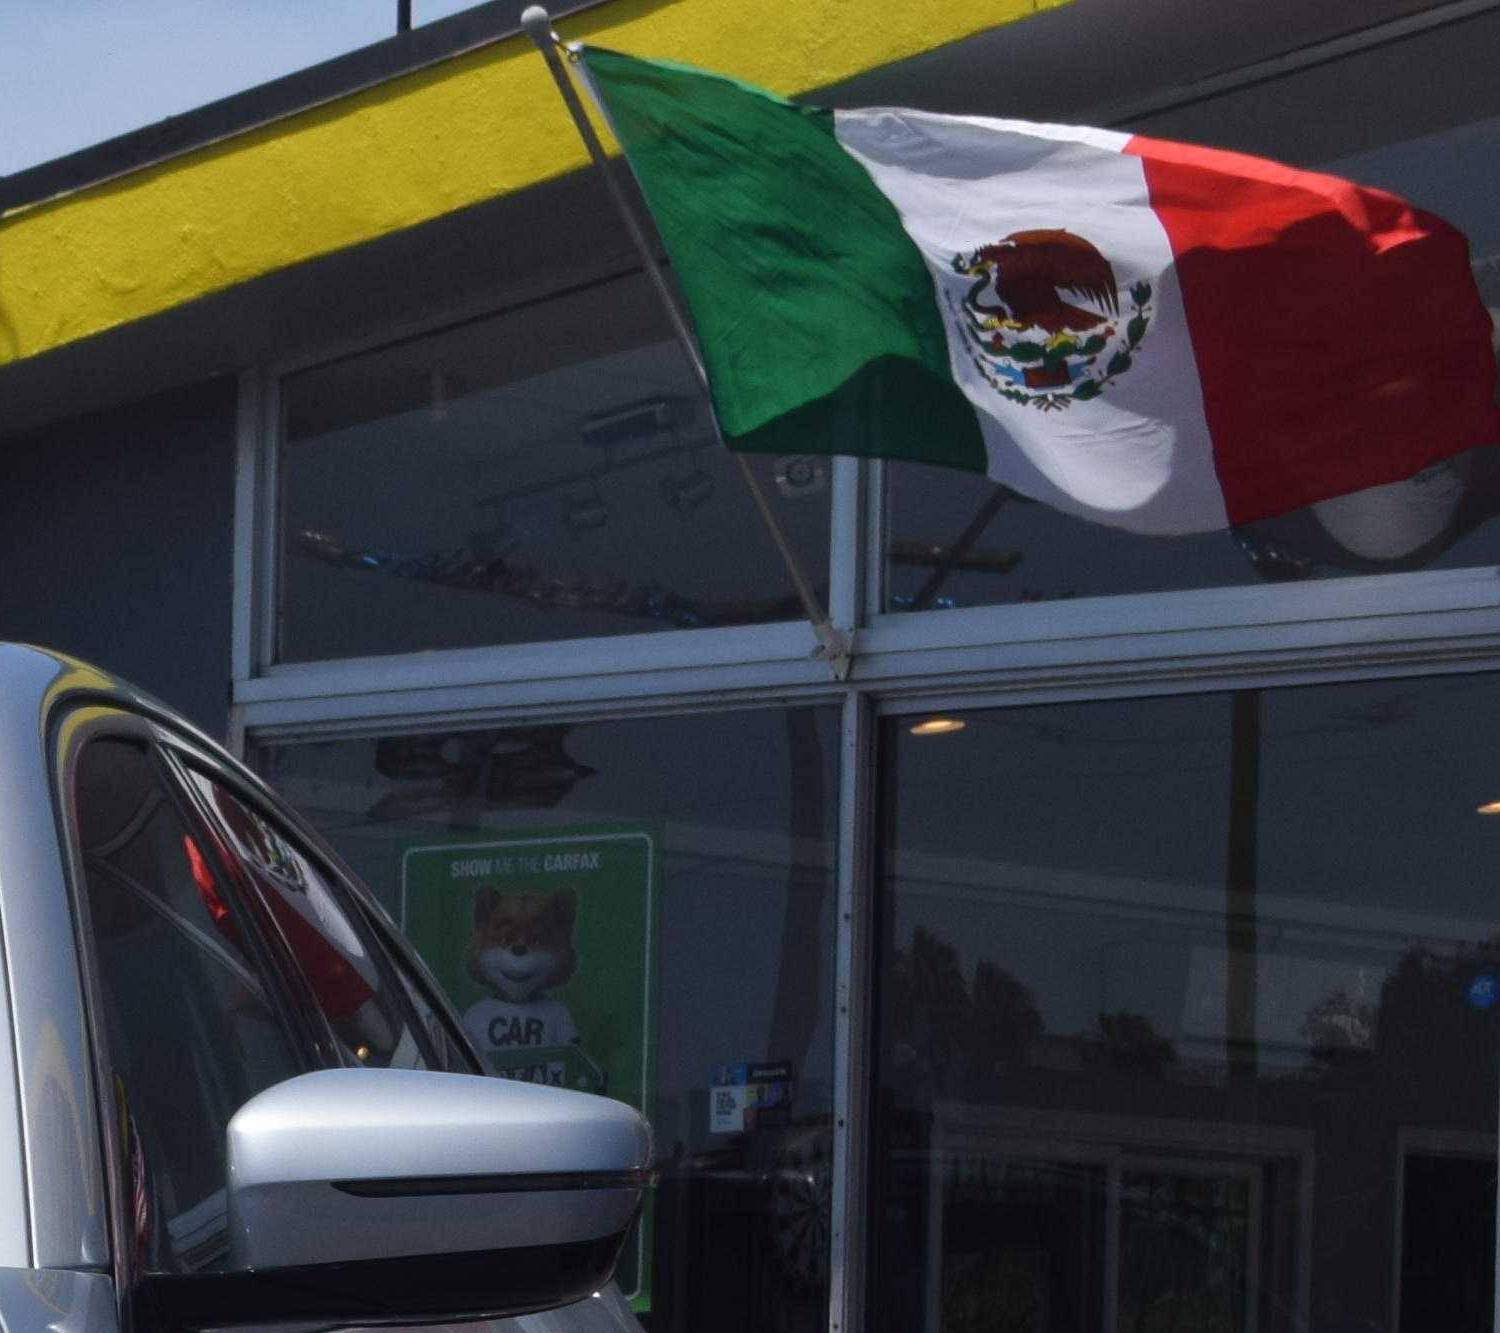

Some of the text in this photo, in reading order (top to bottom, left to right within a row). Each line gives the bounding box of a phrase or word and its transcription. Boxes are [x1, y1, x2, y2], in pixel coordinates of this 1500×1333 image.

[450, 858, 492, 878] SHOW
[544, 852, 601, 873] CARFAX
[488, 1016, 545, 1047] CAR
